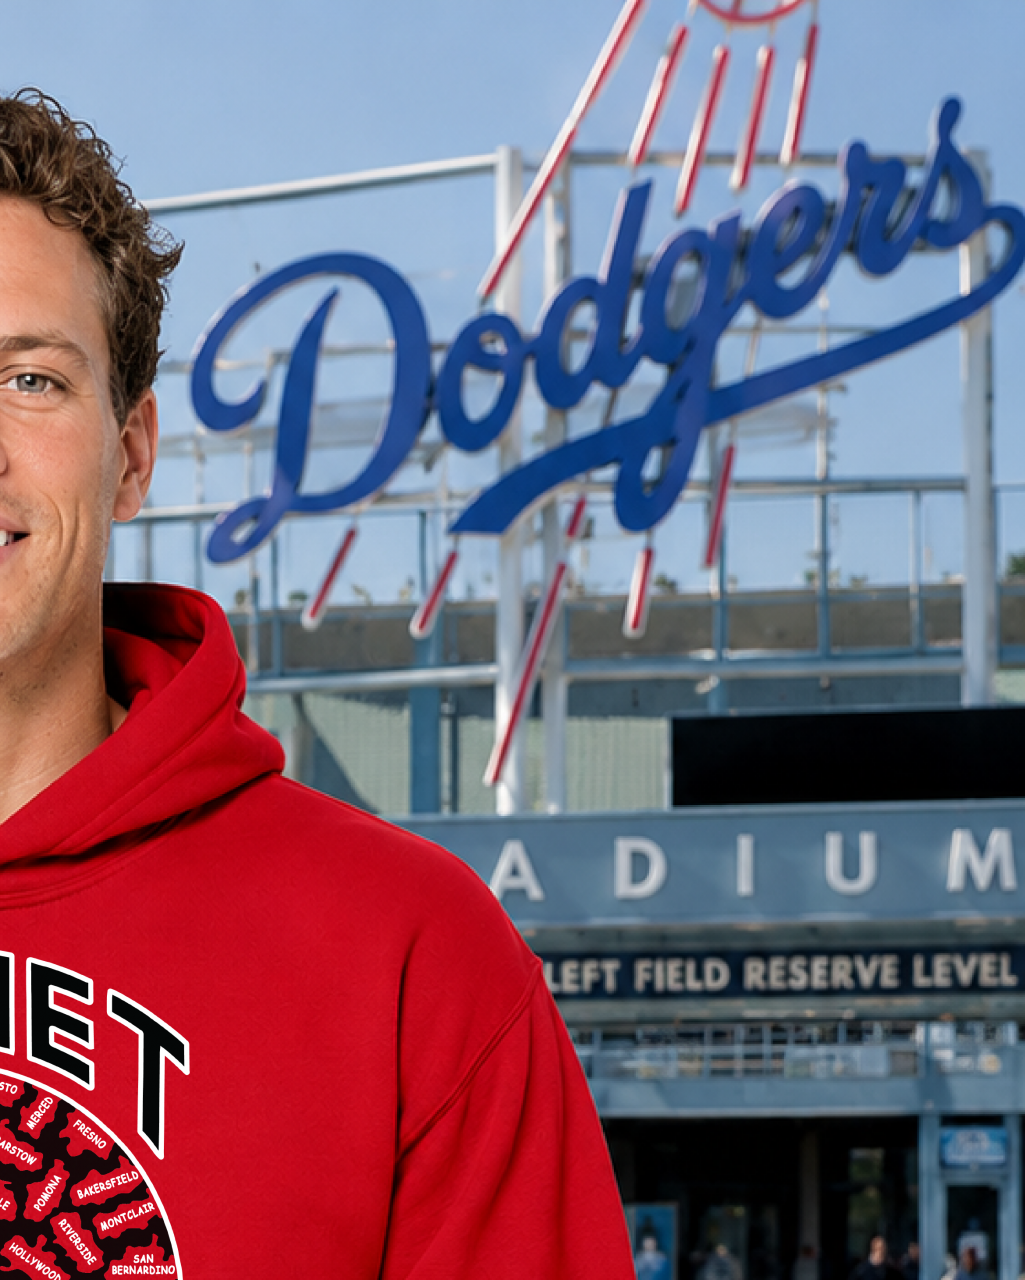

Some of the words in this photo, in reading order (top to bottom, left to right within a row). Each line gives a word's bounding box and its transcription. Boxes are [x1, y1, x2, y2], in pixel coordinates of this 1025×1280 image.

[190, 95, 1025, 563] Dodgers
[490, 828, 1018, 900] ADIUM
[543, 957, 622, 994] LEFT
[633, 957, 731, 993] FIELD
[744, 954, 899, 992] RESERVE
[913, 953, 1017, 988] LEVEL
[25, 1096, 54, 1130] MERCED
[72, 1119, 107, 1149] FRESNO
[33, 1174, 62, 1212] POMONA
[76, 1170, 139, 1200] BAKERSFIELD
[100, 1201, 156, 1232] MONTCLAIR
[57, 1218, 98, 1266] RIVERSIDE
[133, 1253, 154, 1264] SAN
[111, 1264, 176, 1276] BERNARDINO
